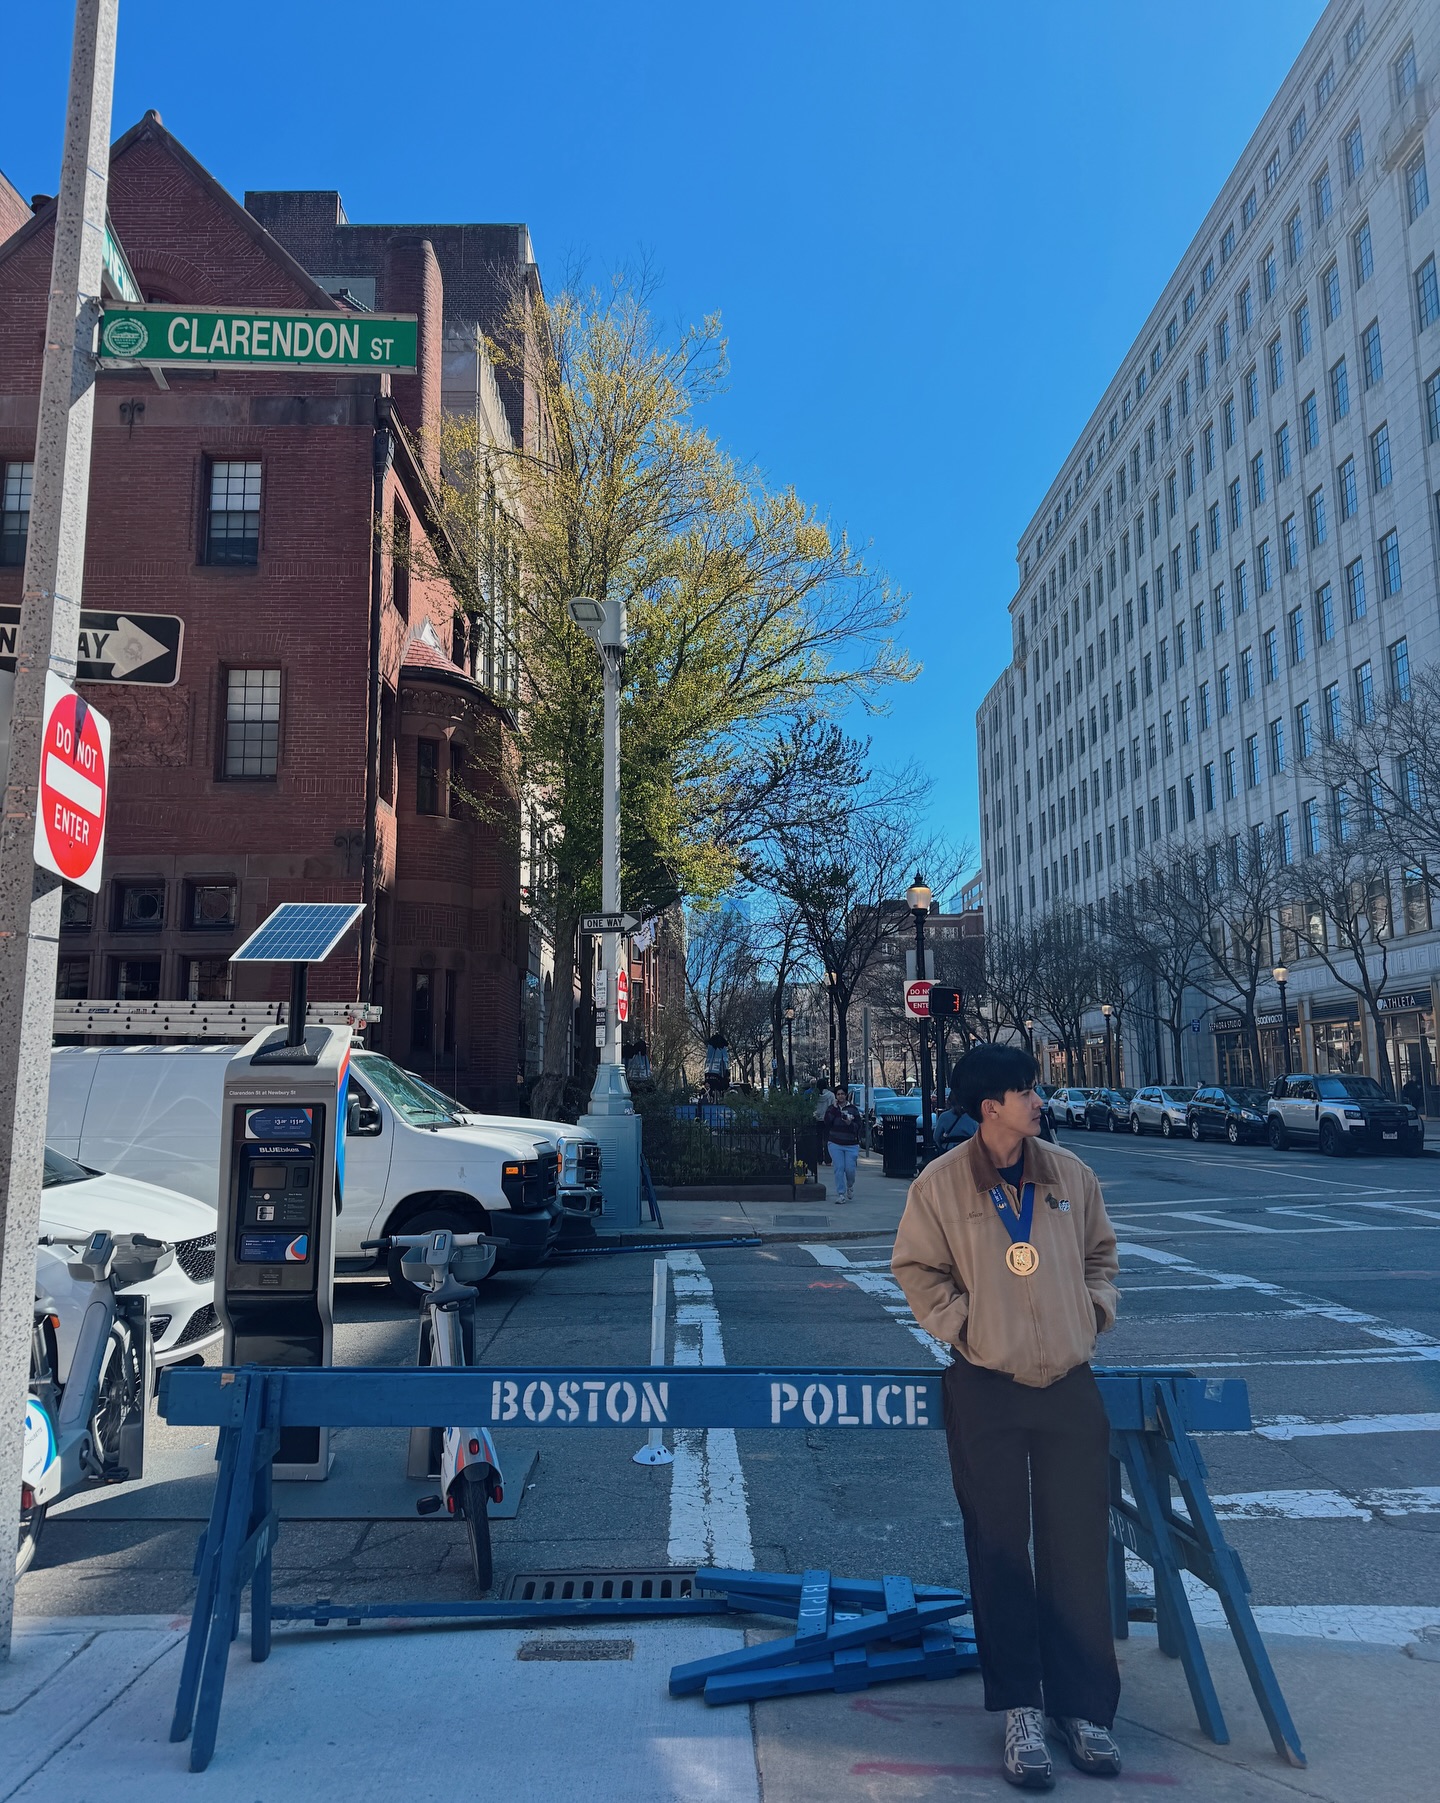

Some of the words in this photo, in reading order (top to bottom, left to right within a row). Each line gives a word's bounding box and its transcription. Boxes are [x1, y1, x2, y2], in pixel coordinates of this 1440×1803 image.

[167, 316, 360, 359] CLARENDON
[370, 337, 394, 360] ST
[77, 631, 111, 659] AY
[55, 721, 72, 755] DO
[76, 737, 98, 774] NOT
[54, 803, 90, 846] ENTER
[587, 919, 603, 928] ONE
[606, 918, 623, 927] WAY
[952, 993, 960, 1012] 3
[1382, 995, 1416, 1009] ATHLETA
[491, 1380, 669, 1423] BOSTON
[771, 1382, 929, 1425] POLICE
[800, 1584, 828, 1617] BPD
